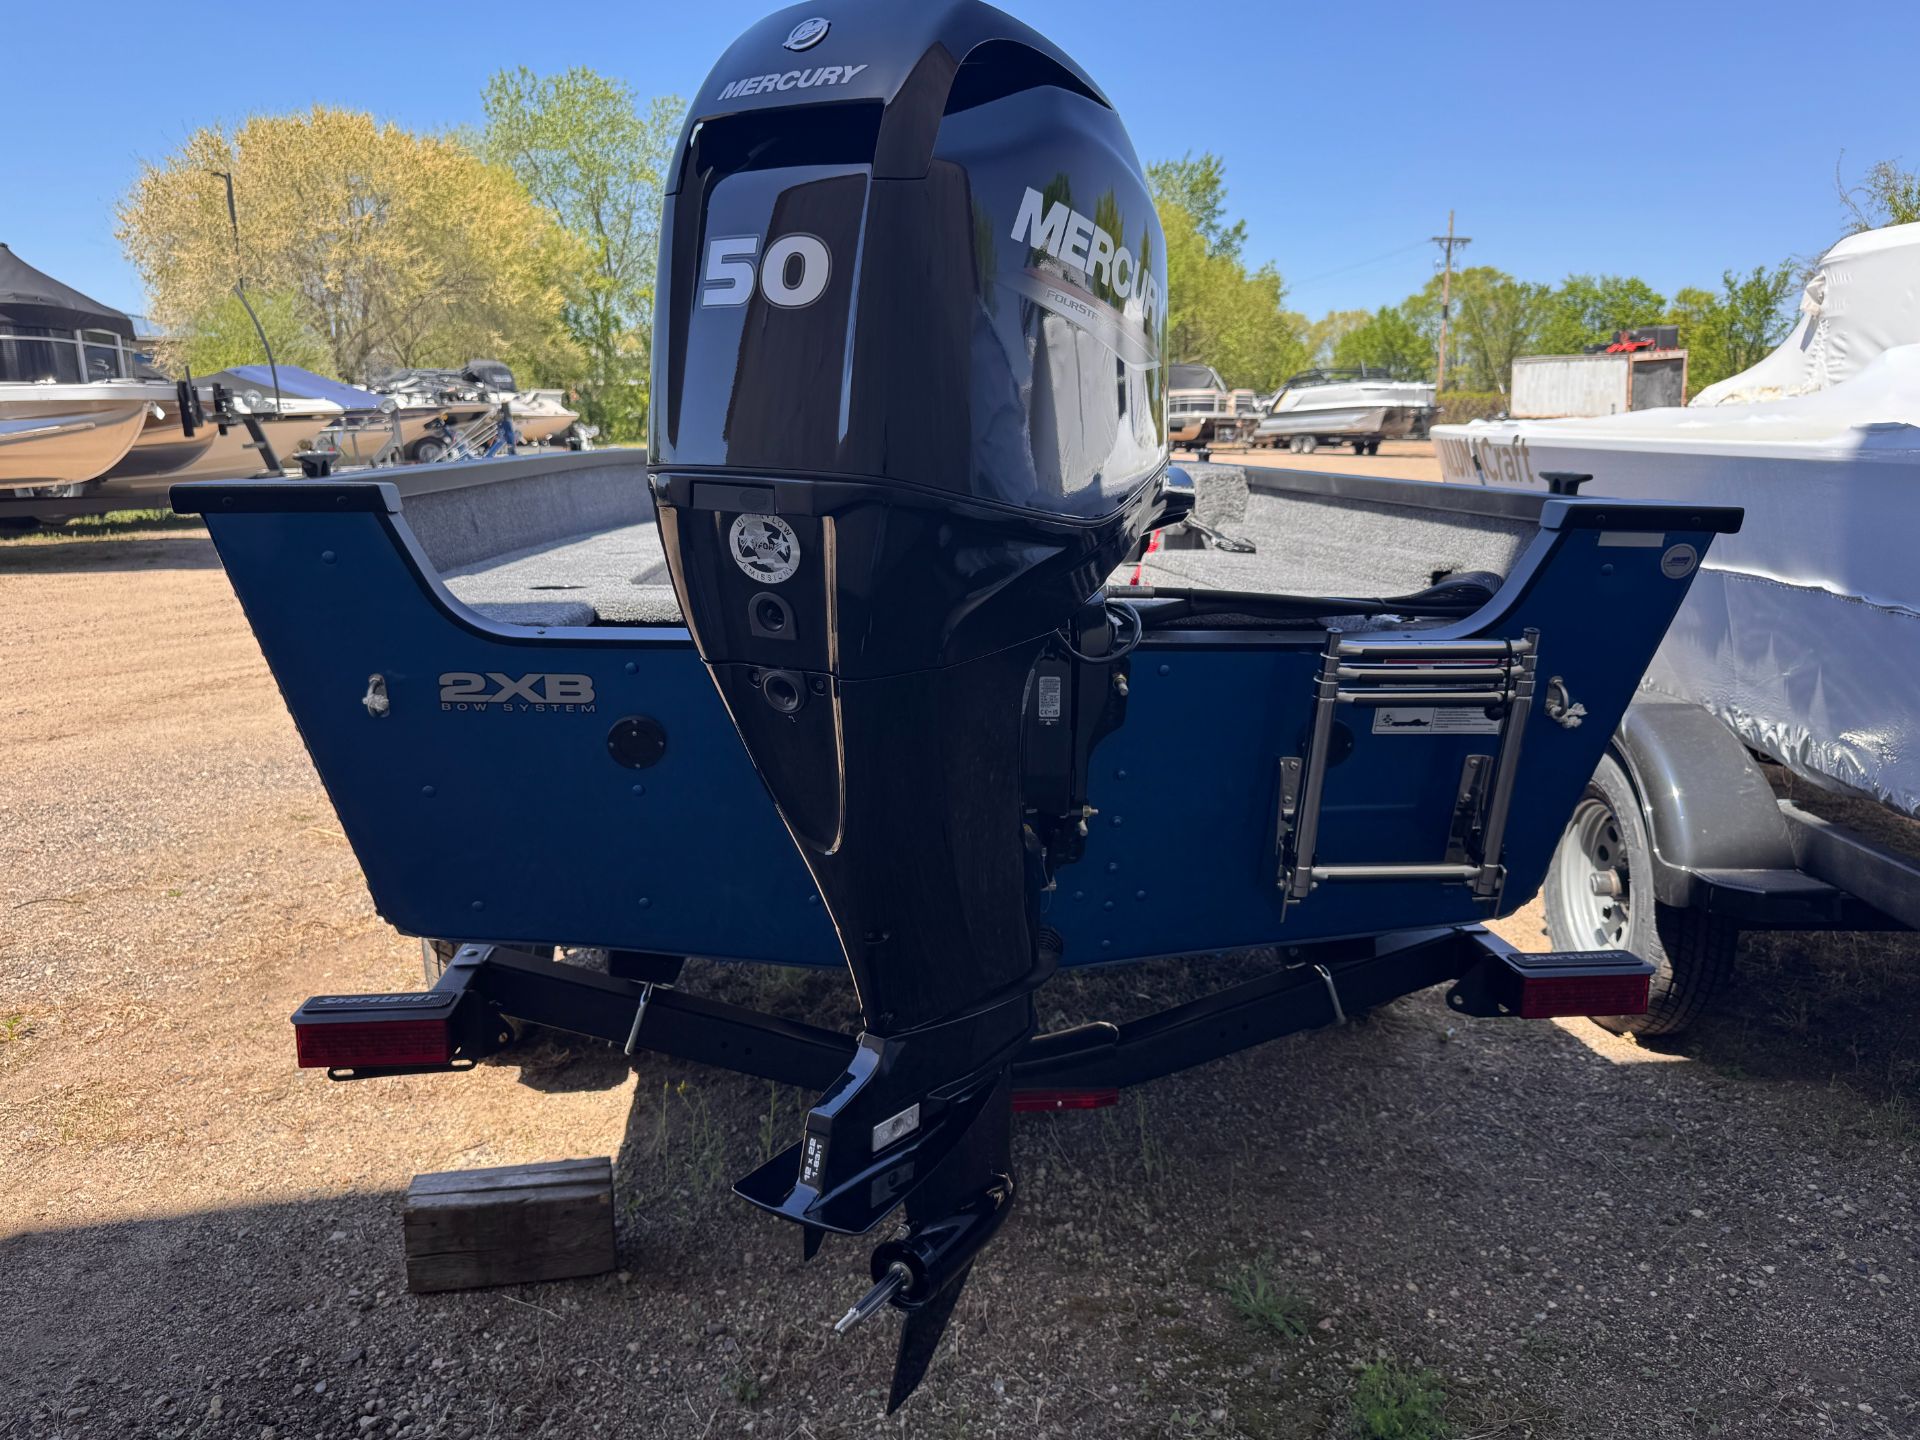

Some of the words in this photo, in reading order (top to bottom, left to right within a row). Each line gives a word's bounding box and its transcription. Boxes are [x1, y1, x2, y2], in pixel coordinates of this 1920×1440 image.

[717, 64, 868, 101] MERCURY
[701, 231, 833, 310] 50
[438, 672, 596, 704] 2XB
[441, 703, 488, 712] BOW
[503, 704, 596, 713] SYSTEM
